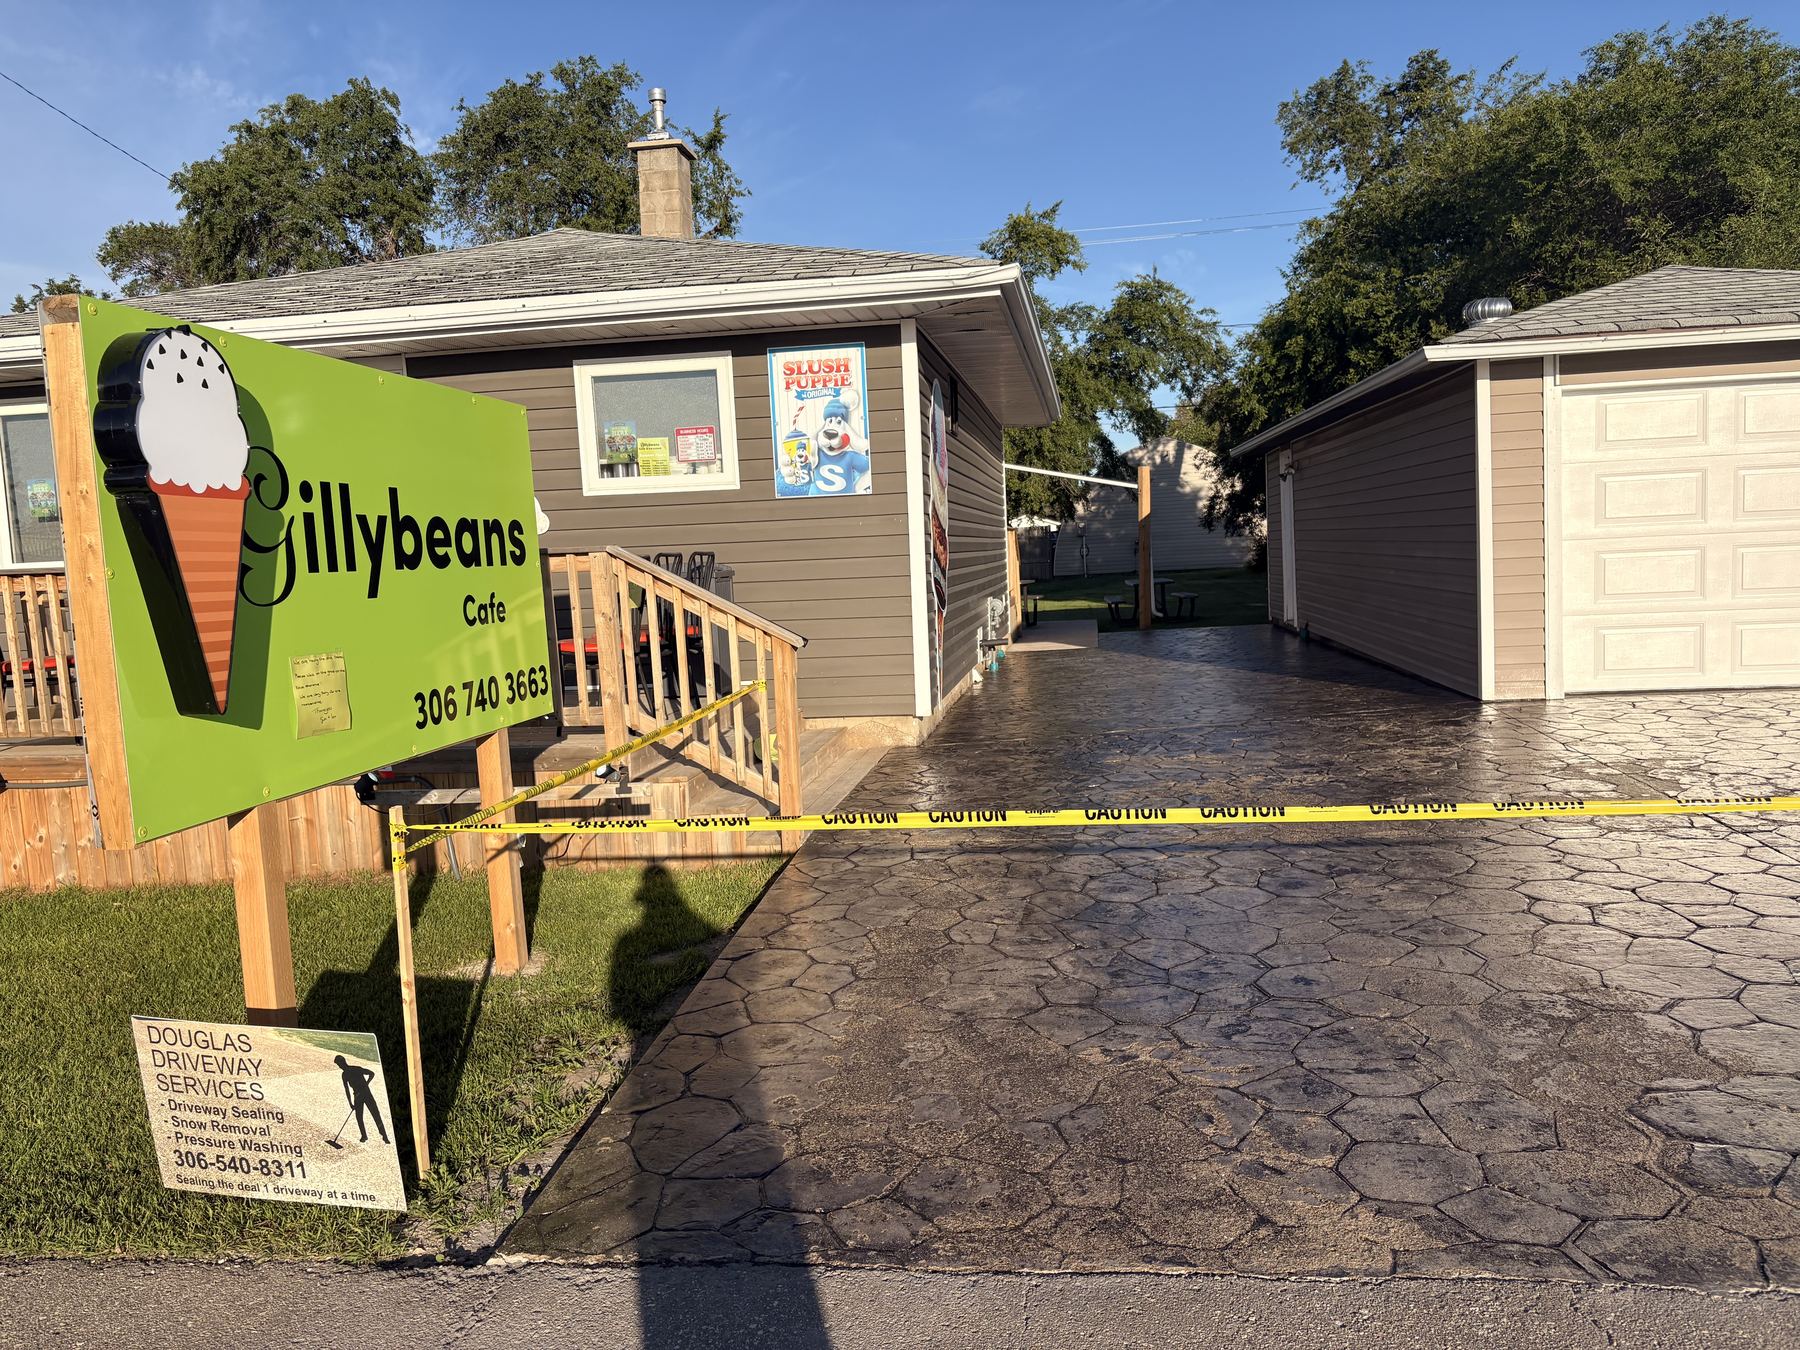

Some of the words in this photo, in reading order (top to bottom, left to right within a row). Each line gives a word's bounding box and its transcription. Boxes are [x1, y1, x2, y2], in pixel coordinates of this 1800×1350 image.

[783, 358, 850, 376] SLUSH
[807, 388, 836, 398] ORIGINAL
[463, 592, 506, 627] Cafe
[414, 692, 458, 730] 306
[462, 676, 500, 716] 740
[505, 665, 549, 705] 3663
[147, 1025, 252, 1053] DOUGLAS
[152, 1049, 262, 1077] DRIVEWAY
[156, 1073, 264, 1101] SERVICES
[168, 1099, 228, 1119] Driveway
[232, 1105, 285, 1124] Sealing
[172, 1116, 207, 1130] Snow
[211, 1120, 271, 1137] Removal
[175, 1132, 236, 1150] Pressure
[239, 1139, 304, 1158] Washing
[174, 1149, 307, 1179] 306-540-8311
[176, 1174, 216, 1189] Sealing
[217, 1179, 234, 1190] the
[238, 1181, 260, 1193] deal
[263, 1184, 269, 1193] 1
[273, 1185, 323, 1199] driveway
[327, 1190, 338, 1199] at
[341, 1192, 348, 1200] a
[351, 1191, 376, 1202] time
